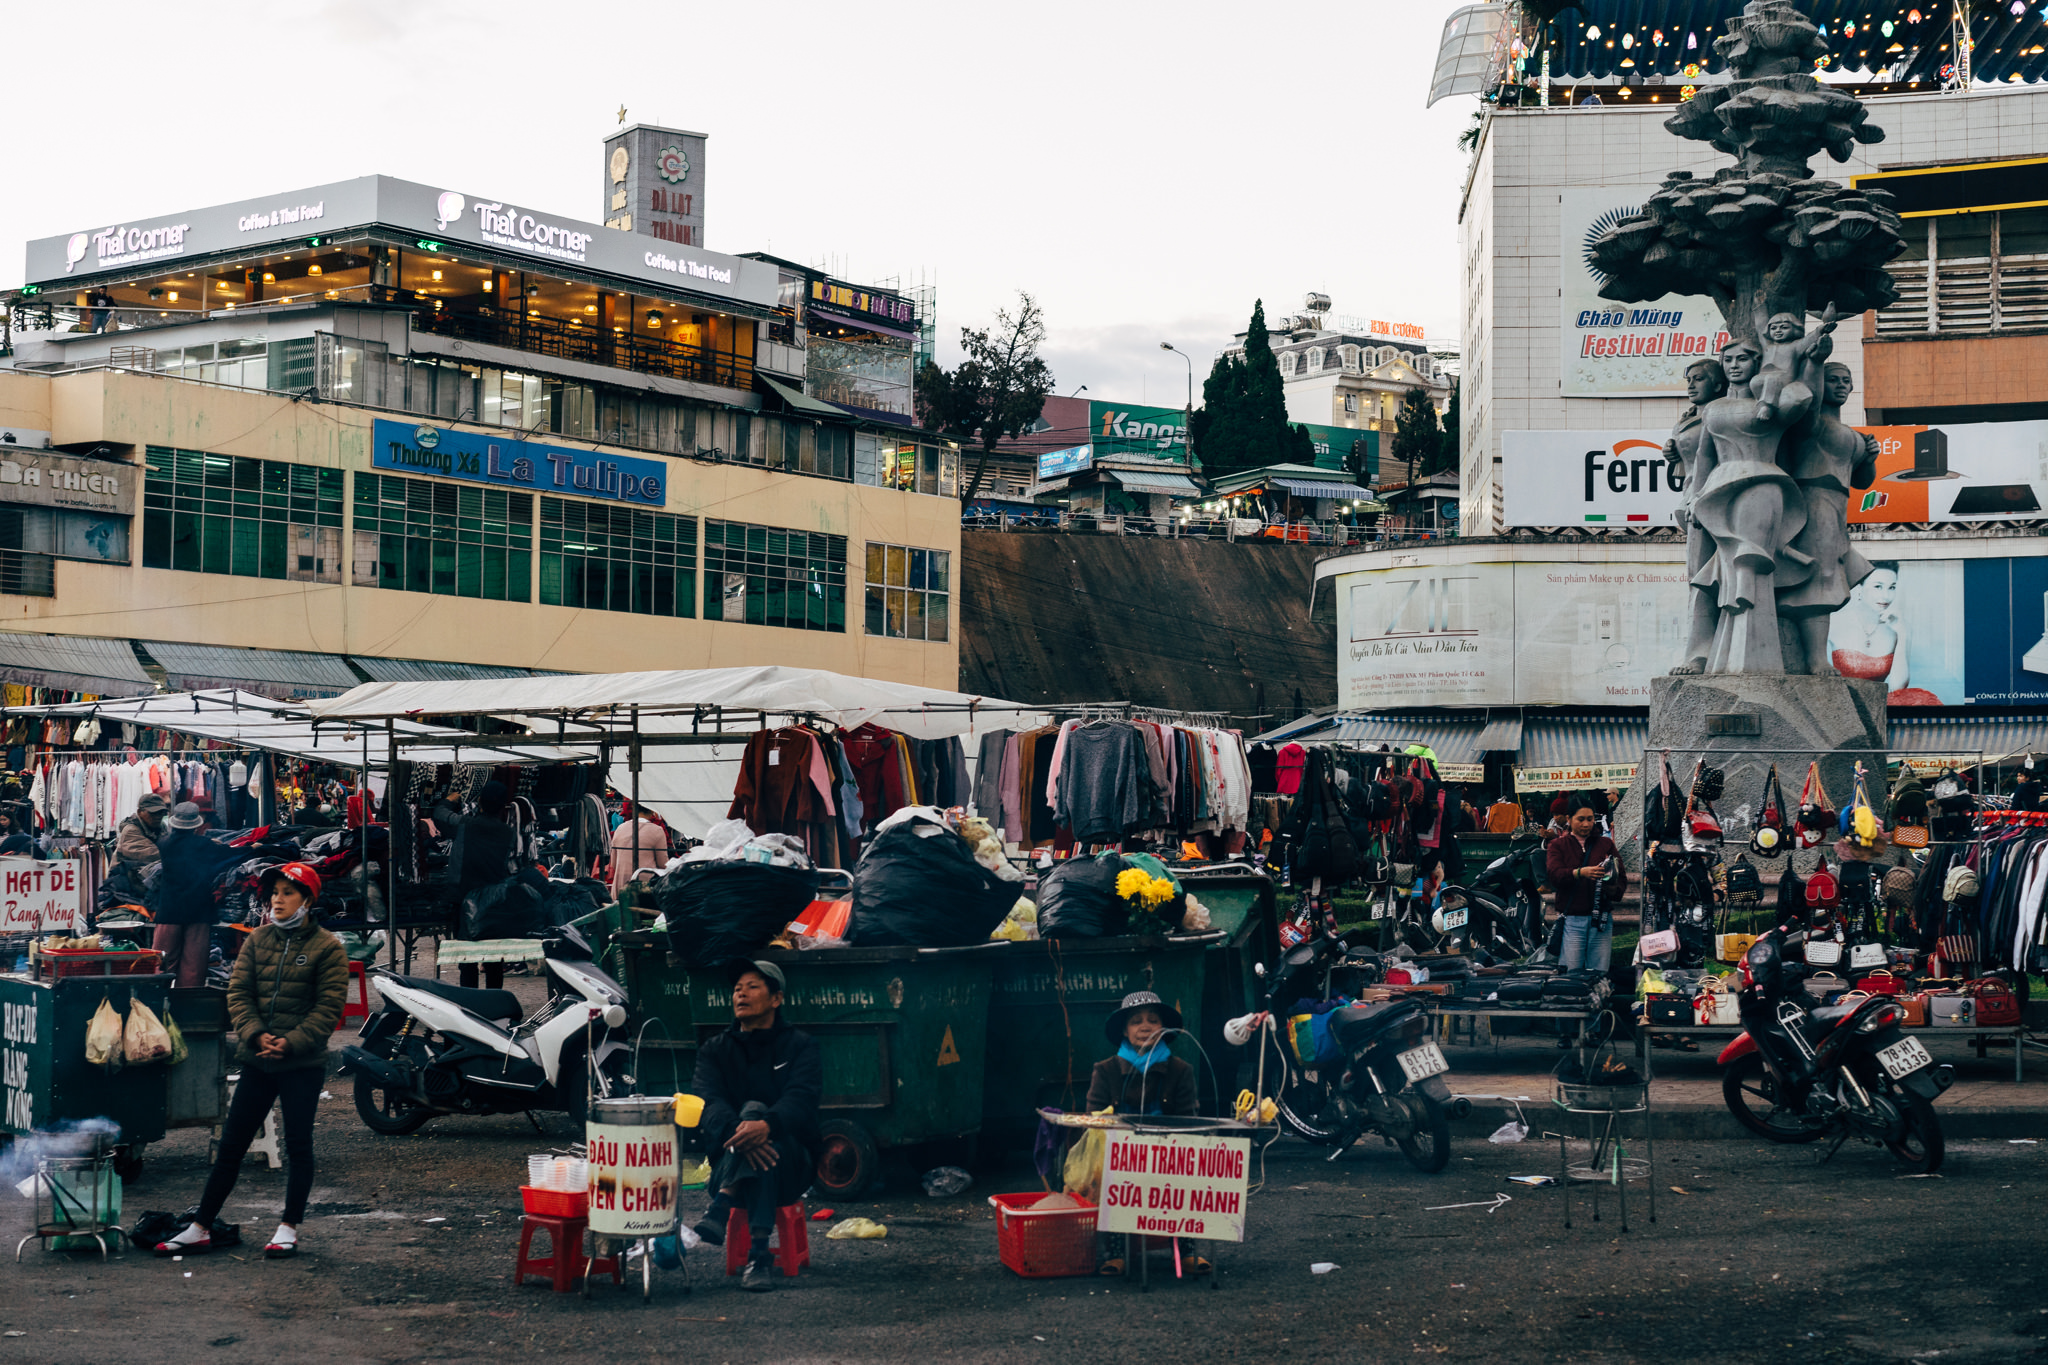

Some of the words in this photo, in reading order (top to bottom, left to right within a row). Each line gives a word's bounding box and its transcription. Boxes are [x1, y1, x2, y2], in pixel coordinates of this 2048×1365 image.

[238, 214, 270, 231] Coffee
[270, 210, 279, 226] &
[280, 206, 300, 225] Thai
[300, 201, 324, 220] Food
[473, 202, 518, 237] Thai
[519, 215, 592, 252] Corner
[93, 225, 126, 257] Thai
[127, 223, 190, 251] Corner
[644, 251, 677, 272] Coffee
[678, 259, 687, 275] &
[687, 261, 707, 280] Thai
[708, 265, 731, 284] Food
[1371, 320, 1390, 335] KIM
[1576, 309, 1624, 328] Chào
[1628, 308, 1683, 328] Mừng
[1582, 332, 1665, 358] Festival
[1668, 332, 1707, 357] Hoa
[389, 441, 452, 474] Thương
[457, 451, 480, 475] Xá
[488, 444, 535, 482] La
[548, 453, 662, 500] Tulipe
[1589, 574, 1612, 583] Make
[1614, 575, 1625, 585] up
[1627, 575, 1635, 583] &
[1459, 639, 1478, 653] Tiên
[1606, 685, 1628, 696] Made
[1631, 685, 1639, 695] in
[1976, 691, 1997, 699] CÔNG
[1551, 770, 1563, 780] DÌ
[6, 871, 44, 898] HẠT
[51, 862, 75, 892] DẺ
[4, 900, 40, 930] Rang
[40, 899, 74, 928] Nóng
[1883, 1041, 1915, 1062] 78-H1
[1889, 1051, 1928, 1076] 043.36
[1411, 1059, 1441, 1078] 9126
[590, 1136, 618, 1171] ĐẬU
[625, 1137, 672, 1167] NÀNH
[1110, 1136, 1148, 1173] BÁNH
[1151, 1139, 1195, 1177] TRÁNG
[1198, 1142, 1243, 1179] NƯỚNG
[1107, 1180, 1142, 1208] SỮA
[1149, 1183, 1185, 1215] ĐẬU
[1190, 1185, 1240, 1214] NÀNH
[624, 1220, 650, 1231] Kính
[1137, 1215, 1204, 1234] Nóng/đá
